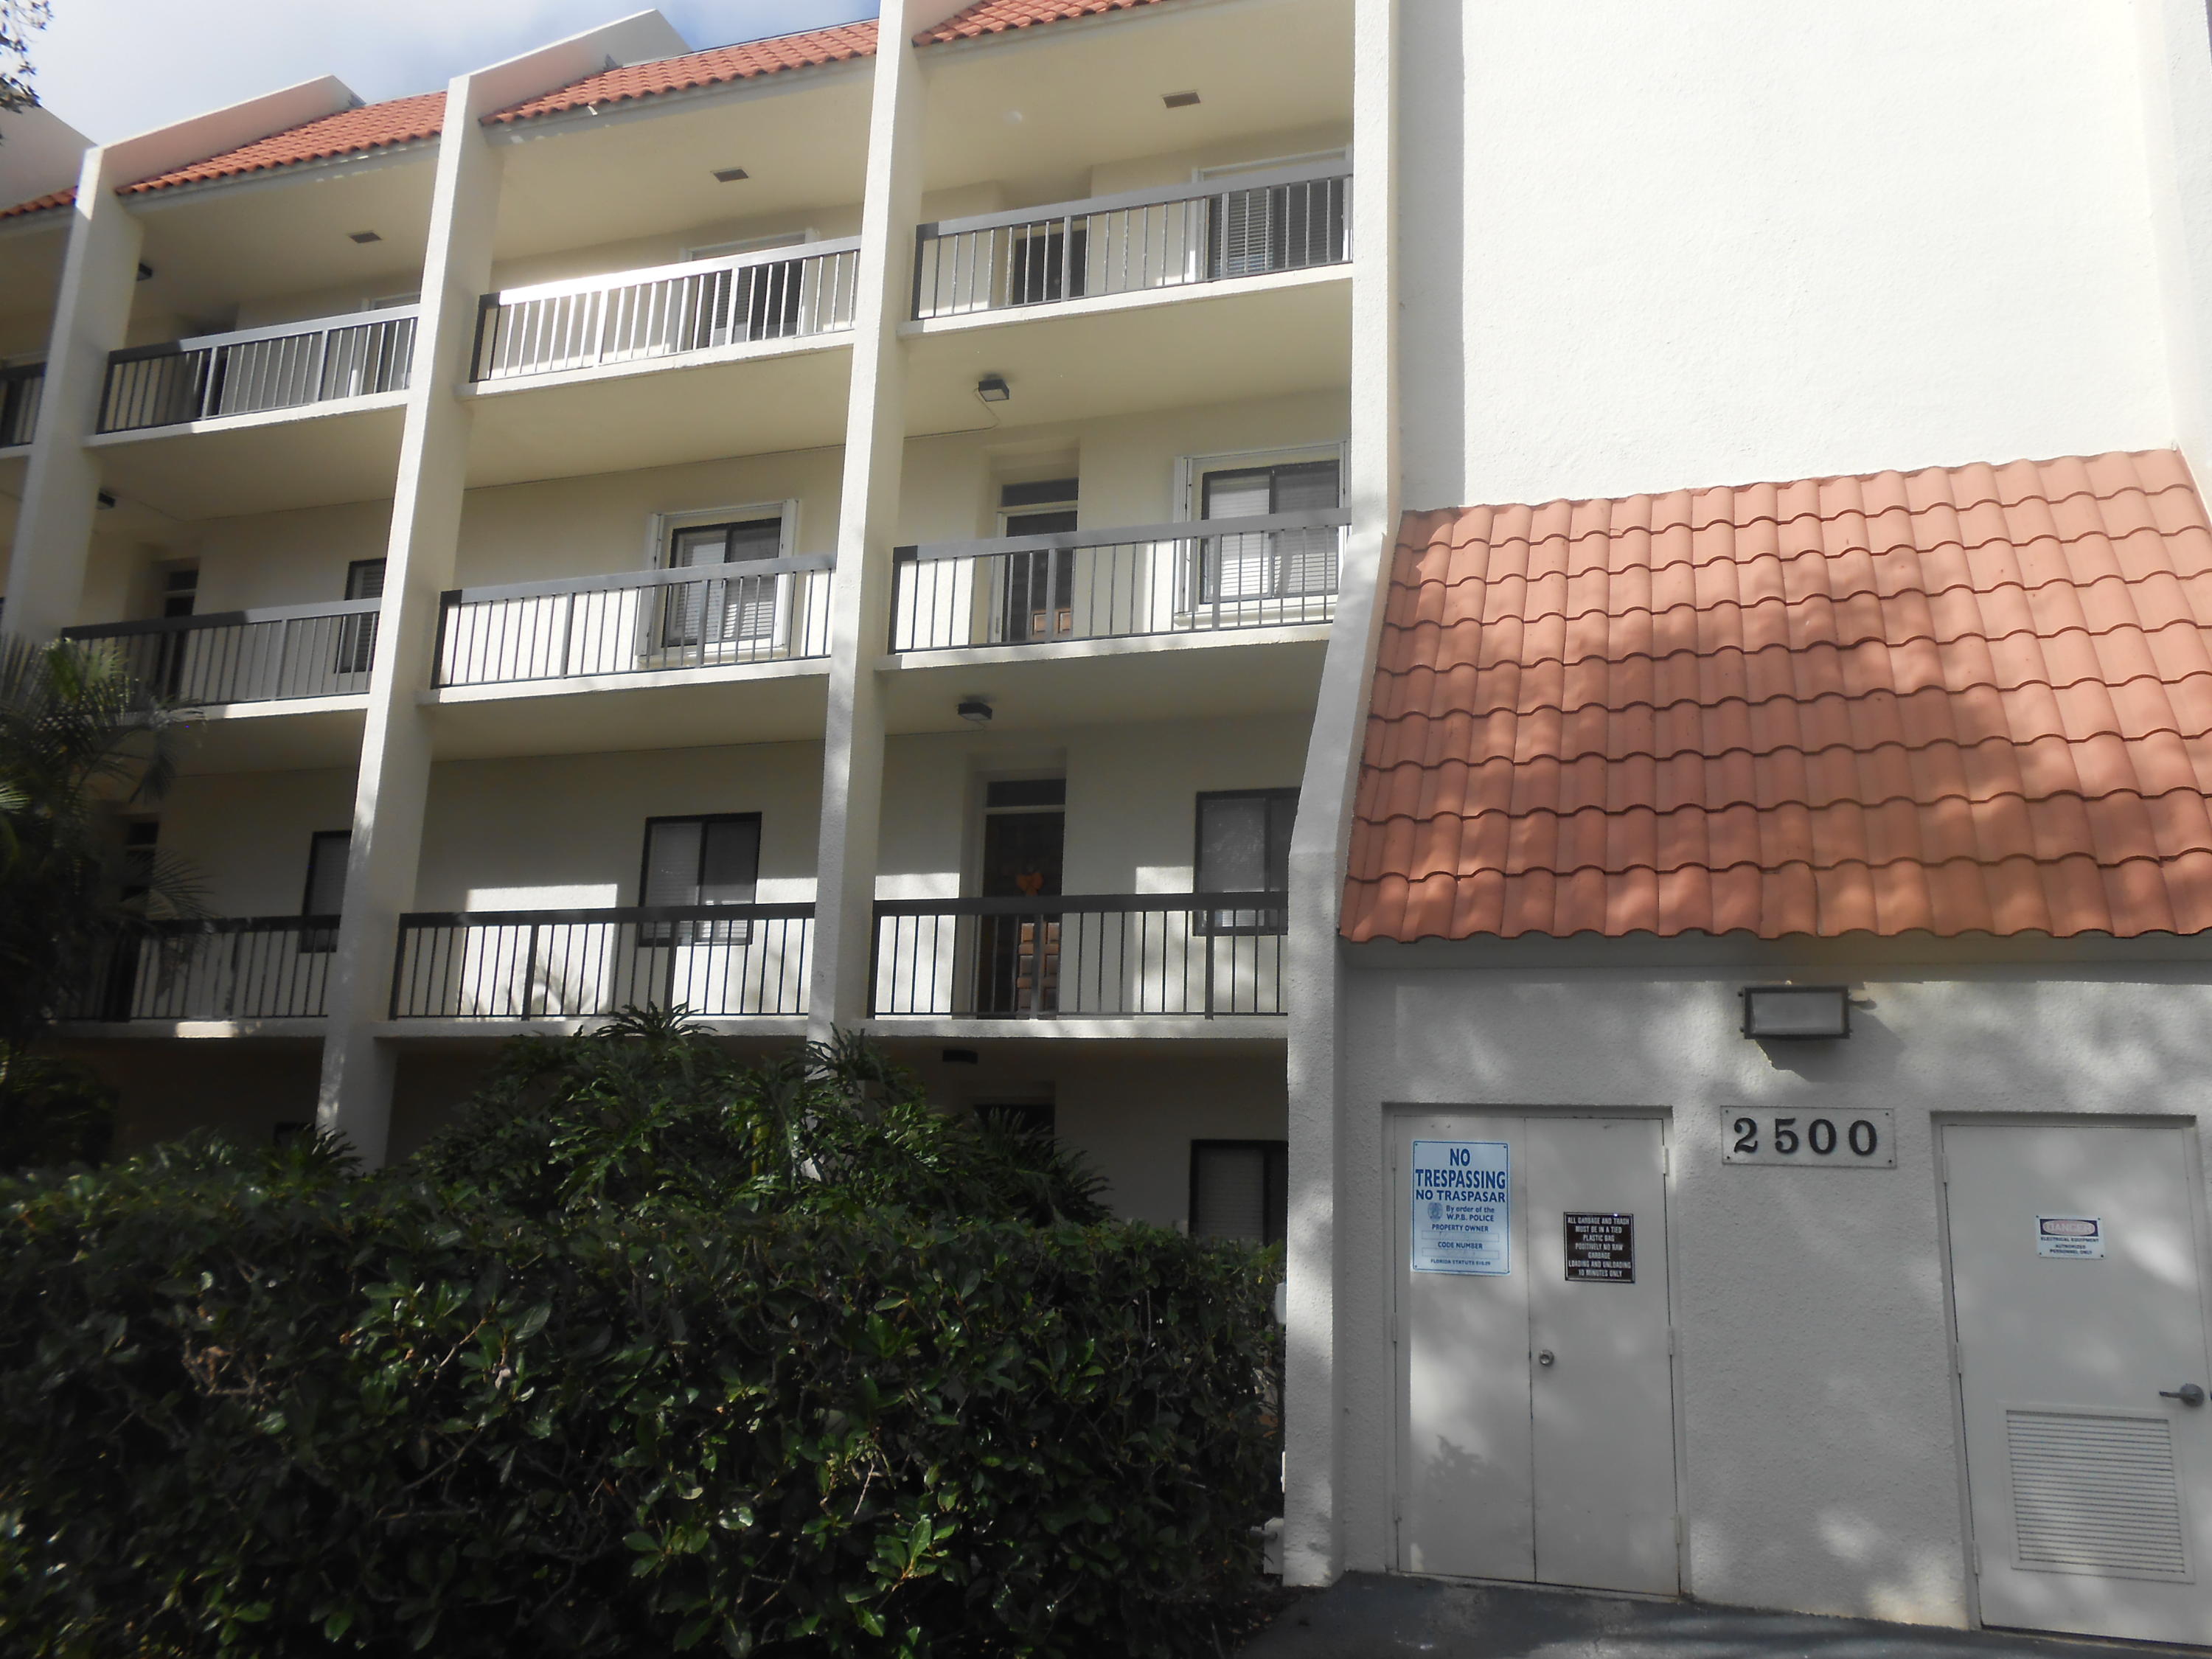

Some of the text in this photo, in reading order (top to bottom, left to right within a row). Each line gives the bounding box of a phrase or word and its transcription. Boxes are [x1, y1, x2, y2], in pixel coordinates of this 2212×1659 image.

[1733, 1117, 1877, 1156] 2500
[1450, 1149, 1470, 1166] NO
[1416, 1169, 1506, 1189] TRESPASSING
[1416, 1190, 1505, 1203] NO TRASPASAR
[2047, 1223, 2093, 1234] DANGER
